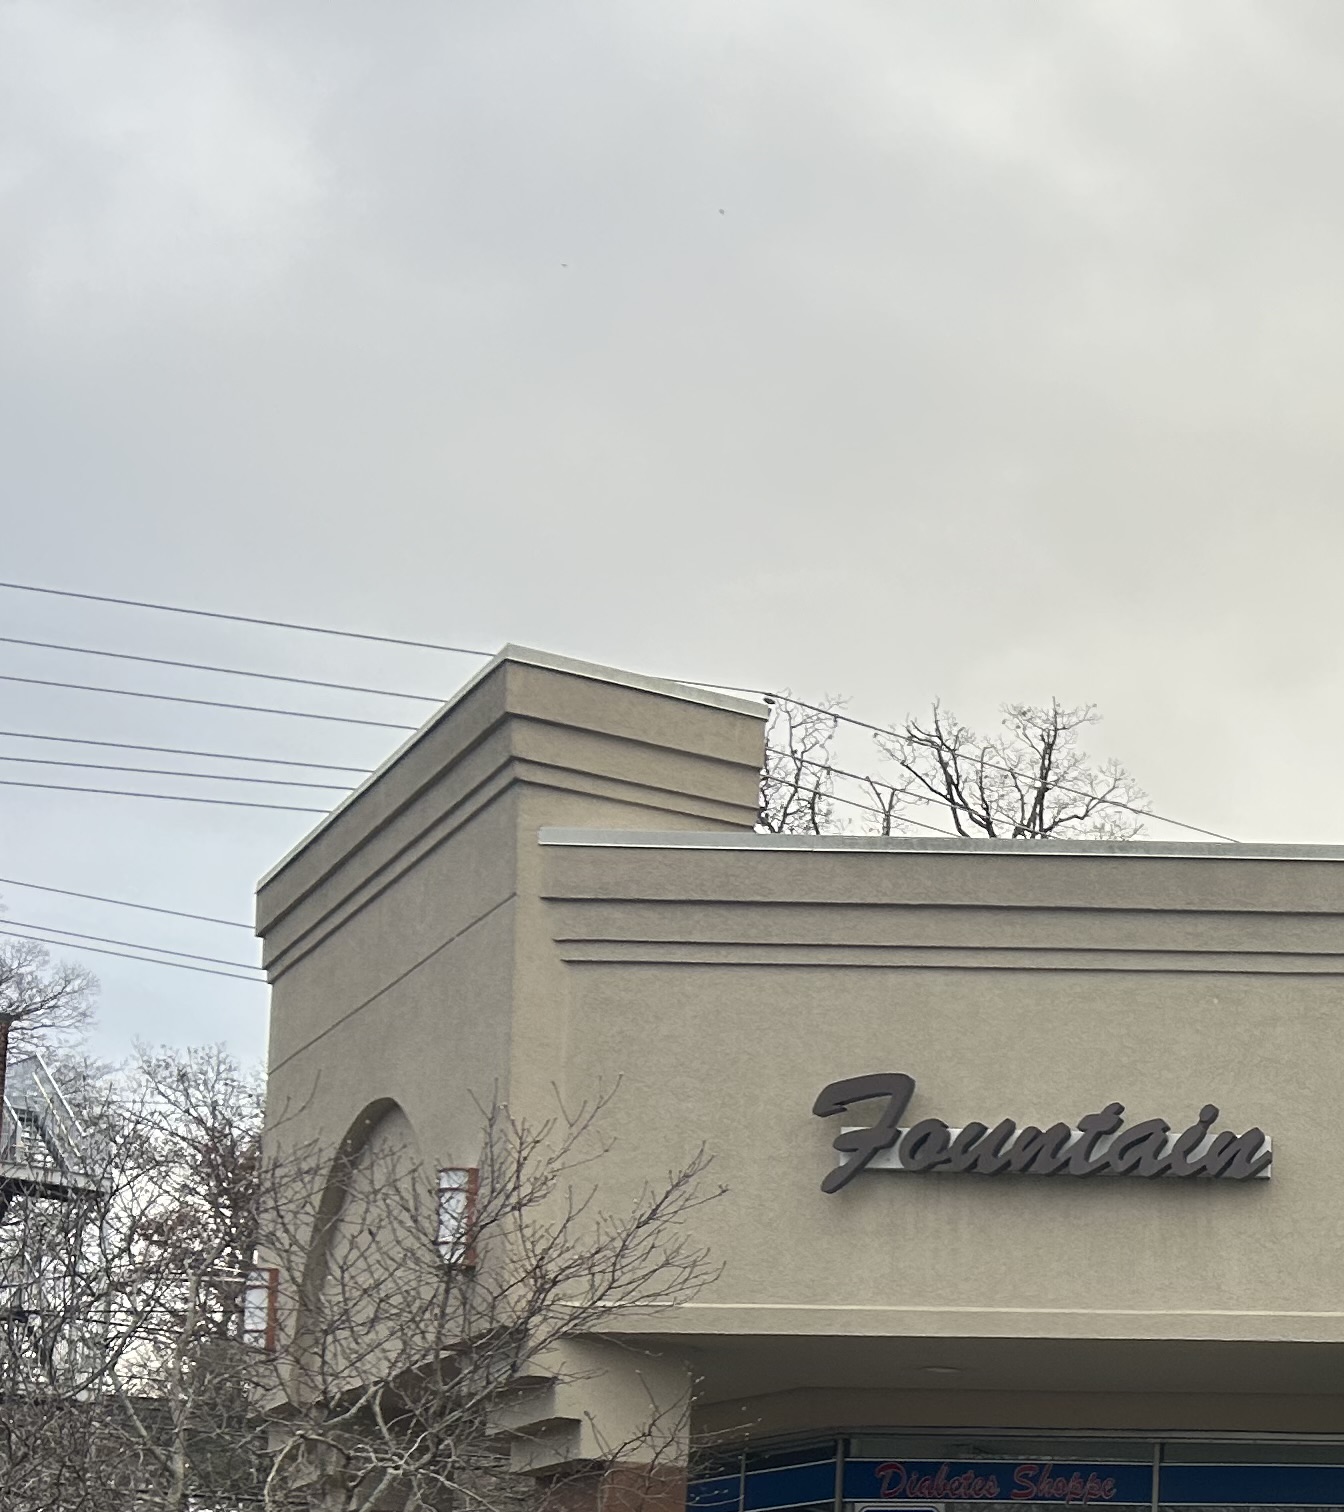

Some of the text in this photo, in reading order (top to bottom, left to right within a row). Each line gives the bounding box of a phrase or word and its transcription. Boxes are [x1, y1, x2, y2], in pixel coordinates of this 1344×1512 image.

[812, 1072, 1273, 1194] Fountain
[874, 1461, 1118, 1505] Diabetes Shoppe
